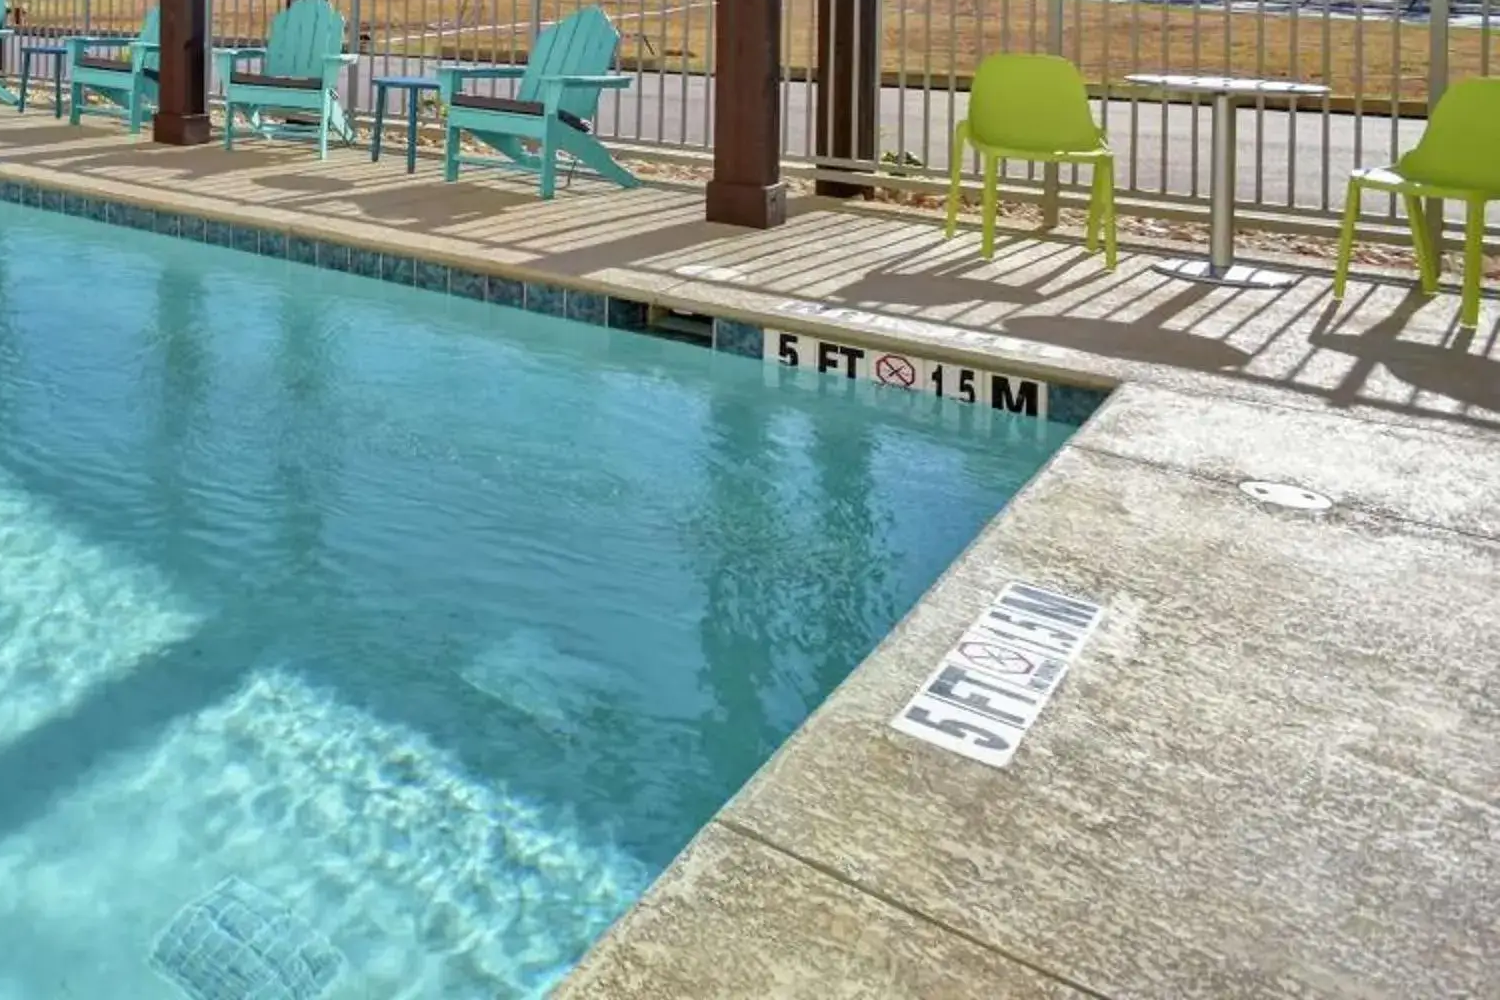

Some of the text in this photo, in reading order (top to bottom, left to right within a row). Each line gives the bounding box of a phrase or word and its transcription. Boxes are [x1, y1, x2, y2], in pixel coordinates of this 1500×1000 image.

[779, 334, 799, 367] 5
[817, 341, 865, 379] FT
[991, 375, 1039, 417] M
[1000, 584, 1099, 629] M
[927, 664, 1038, 725] FT
[904, 705, 1010, 751] 5
